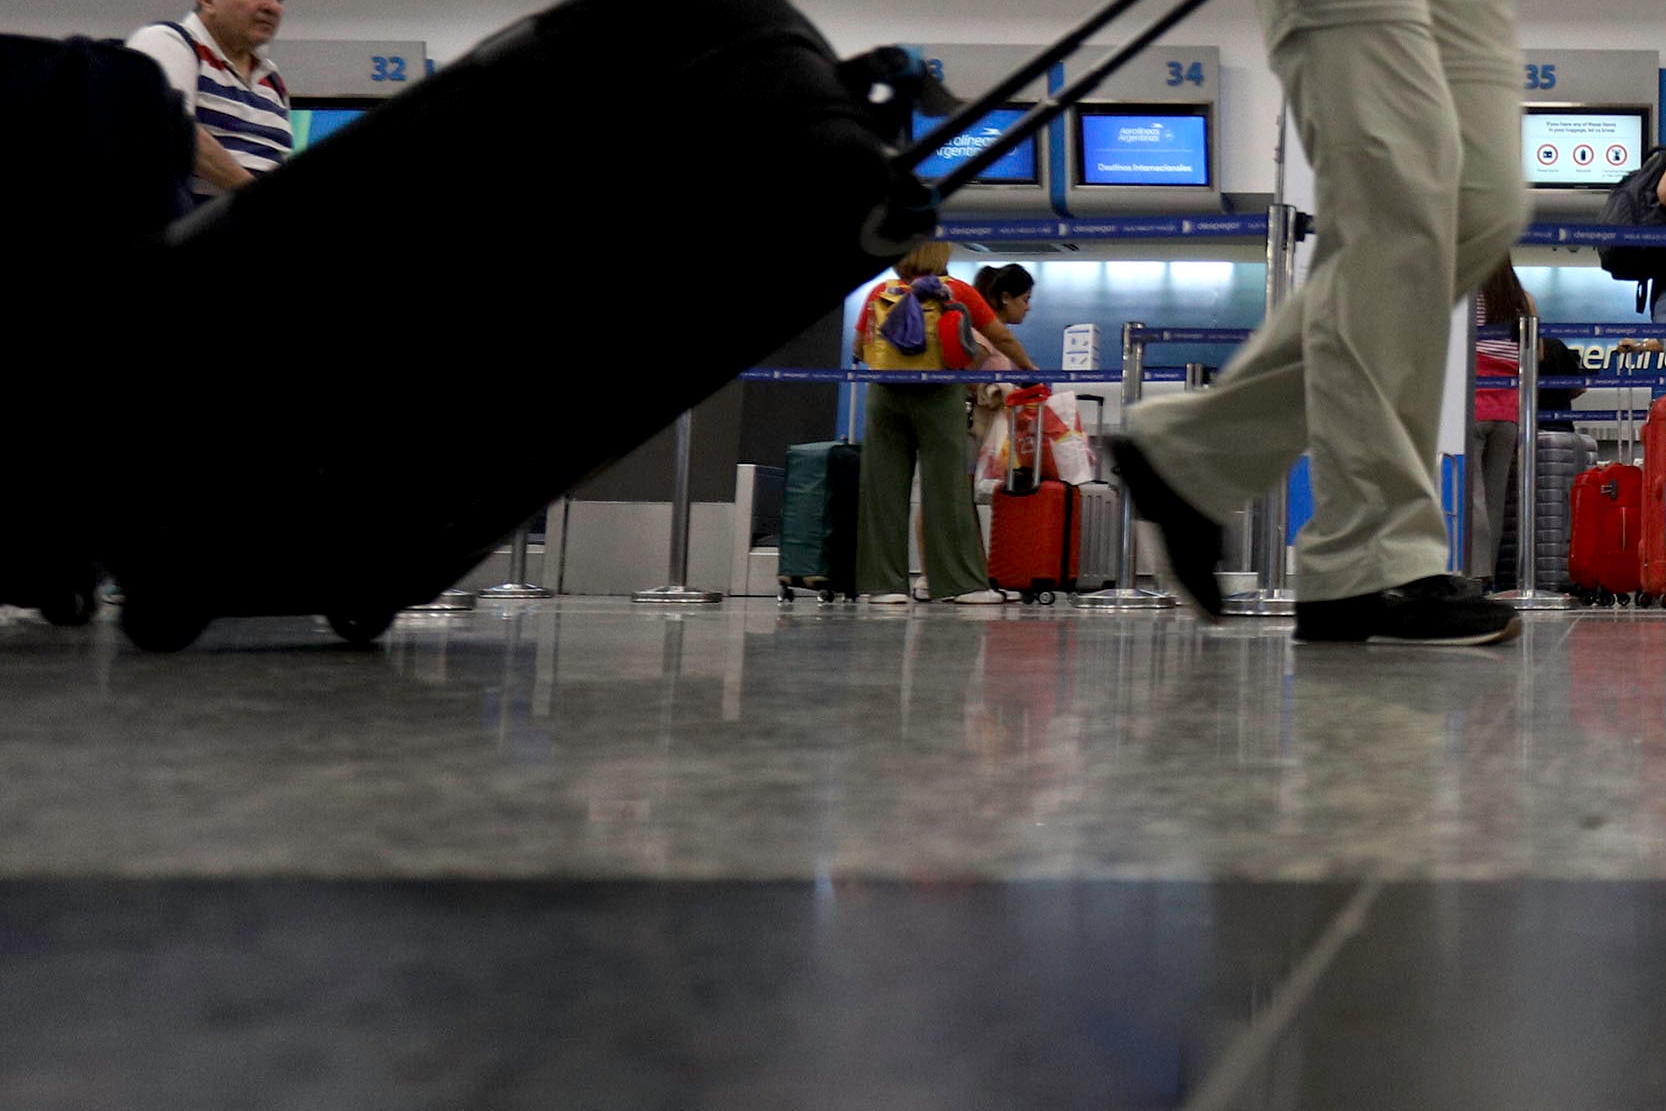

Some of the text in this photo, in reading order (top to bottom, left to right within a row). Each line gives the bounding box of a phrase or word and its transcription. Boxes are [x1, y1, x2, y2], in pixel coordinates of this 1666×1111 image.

[371, 56, 407, 81] 32
[1166, 61, 1204, 87] 34
[1524, 64, 1557, 90] 35
[1573, 231, 1617, 240] despegar
